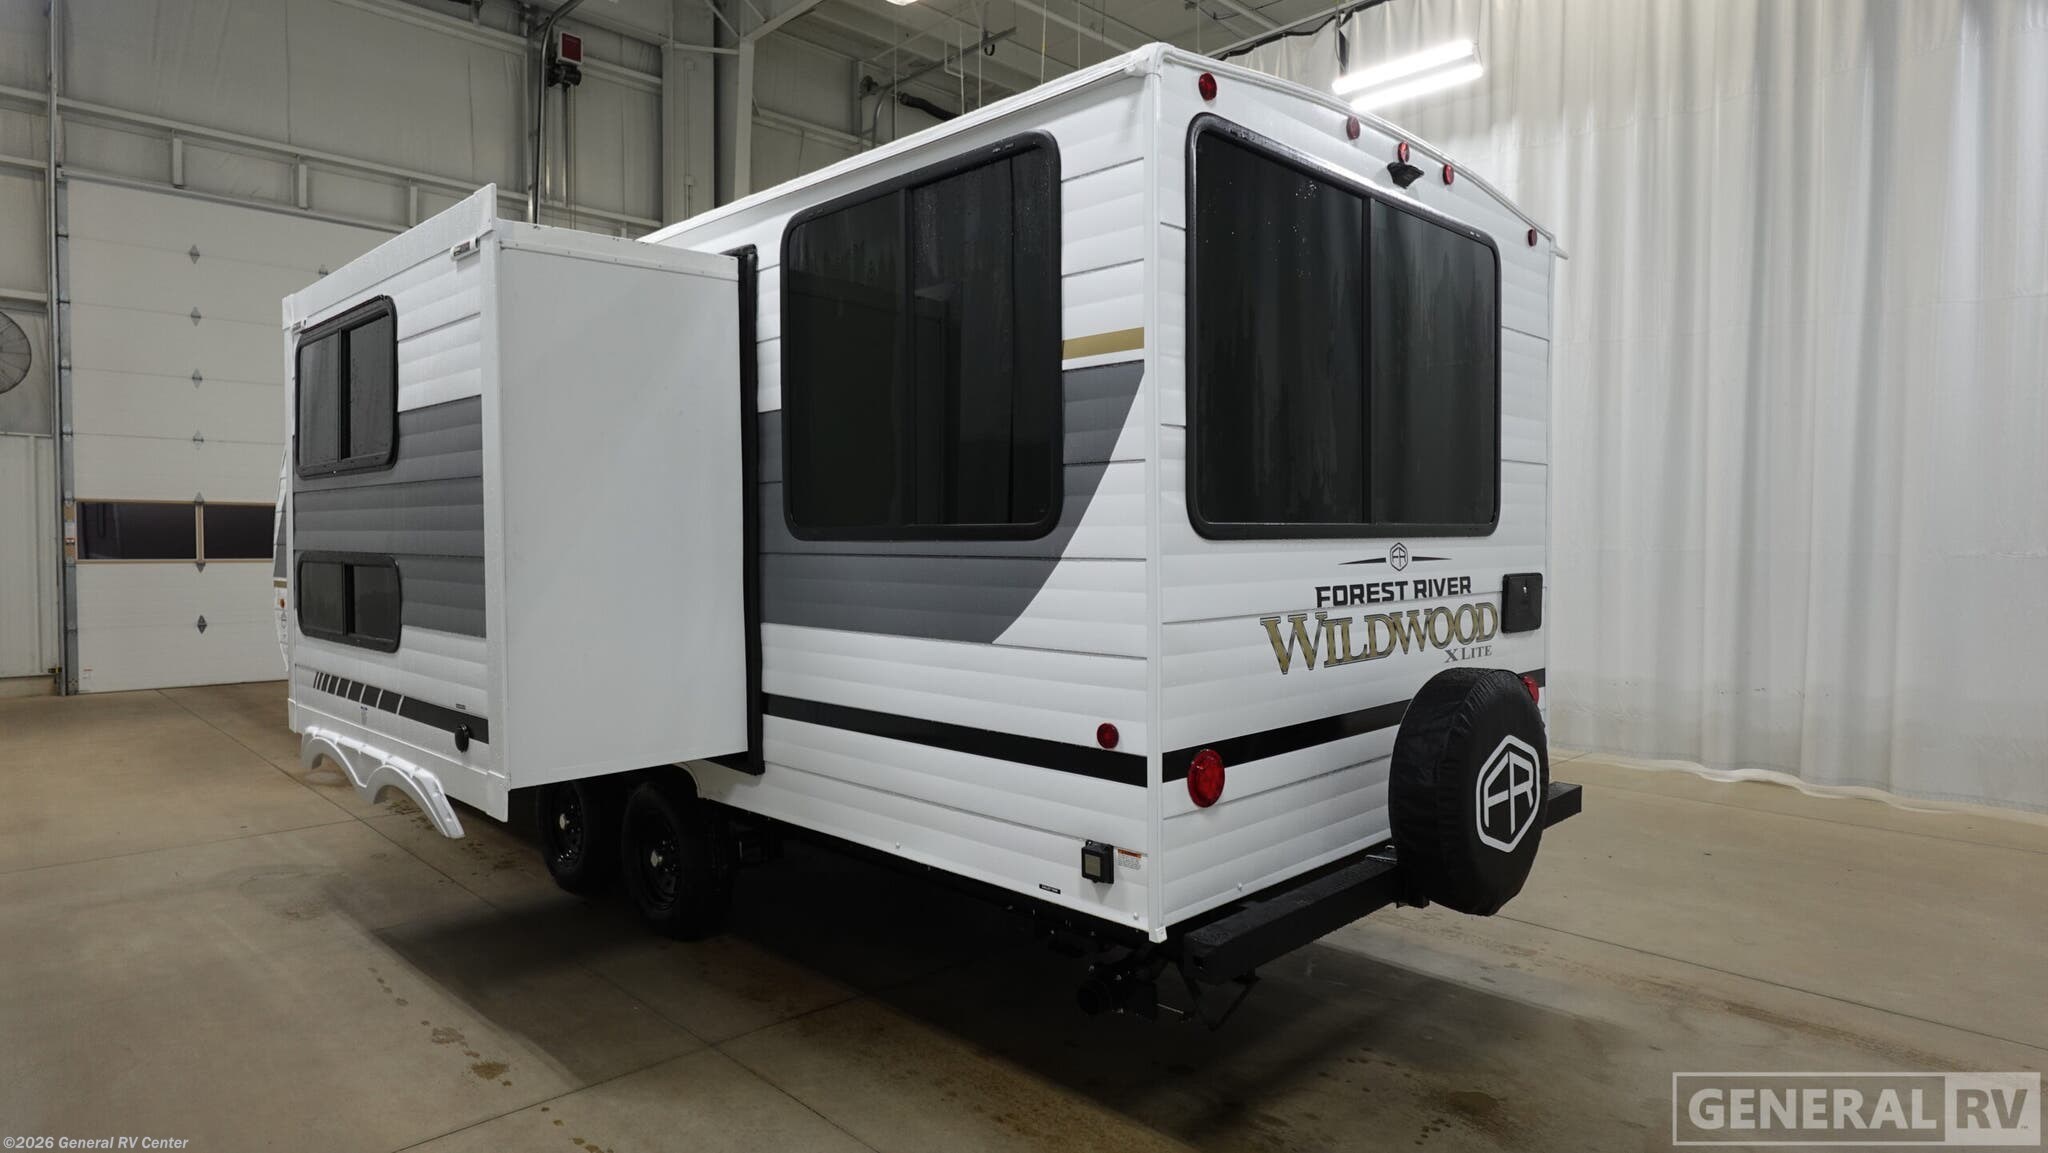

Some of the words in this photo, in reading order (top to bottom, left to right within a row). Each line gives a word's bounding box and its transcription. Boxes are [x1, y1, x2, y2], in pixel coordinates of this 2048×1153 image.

[1314, 580, 1408, 608] FOREST
[1413, 576, 1472, 600] RIVER
[1259, 601, 1499, 675] WILDWOOD
[1444, 648, 1459, 663] X
[1461, 645, 1492, 660] LITE
